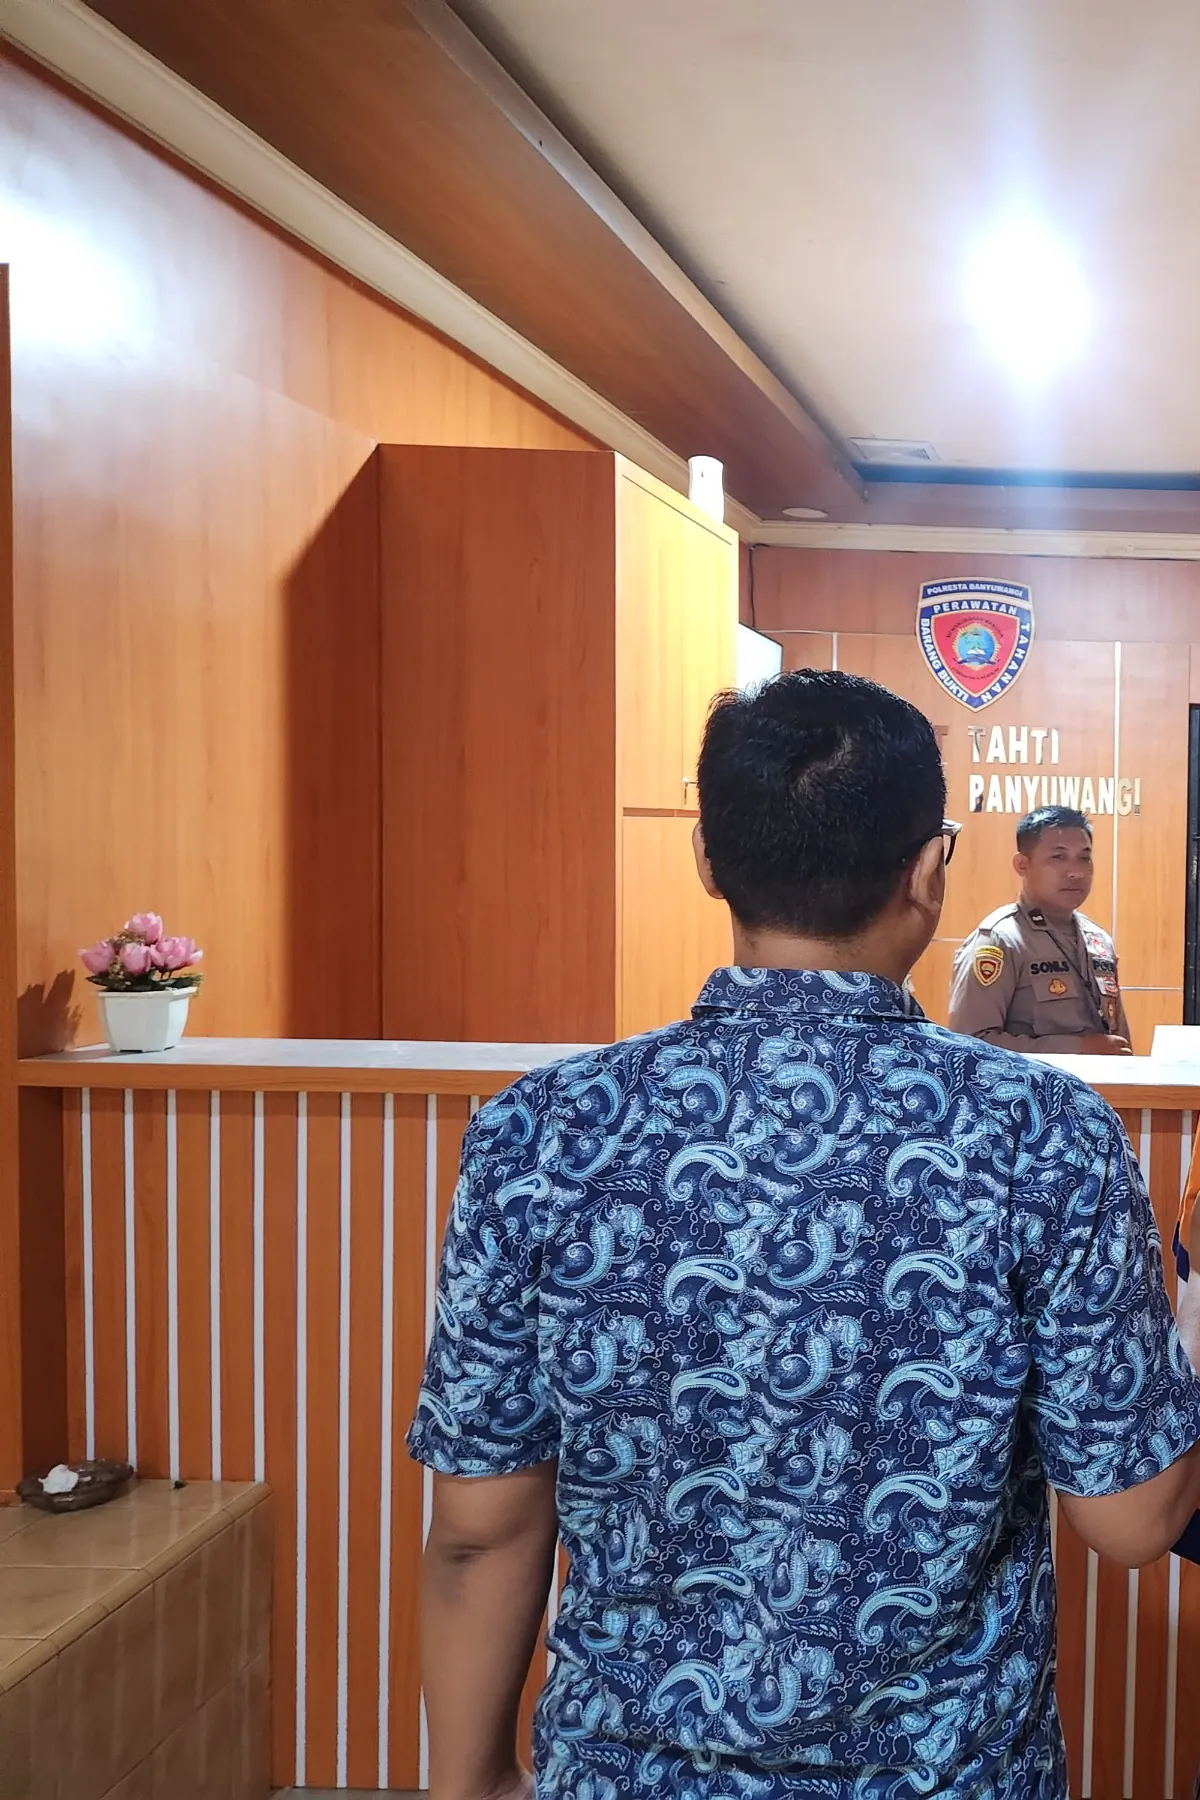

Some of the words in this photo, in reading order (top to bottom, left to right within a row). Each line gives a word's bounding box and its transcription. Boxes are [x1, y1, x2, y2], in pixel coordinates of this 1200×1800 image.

[926, 583, 968, 595] POLRESTA
[969, 583, 1024, 598] BANYUWANGI
[932, 600, 1019, 616] PERAWATAN
[920, 618, 942, 669] BARANG
[981, 622, 1031, 703] TAHANAN
[937, 669, 970, 703] BUKTI
[967, 725, 1060, 765] TAHTI
